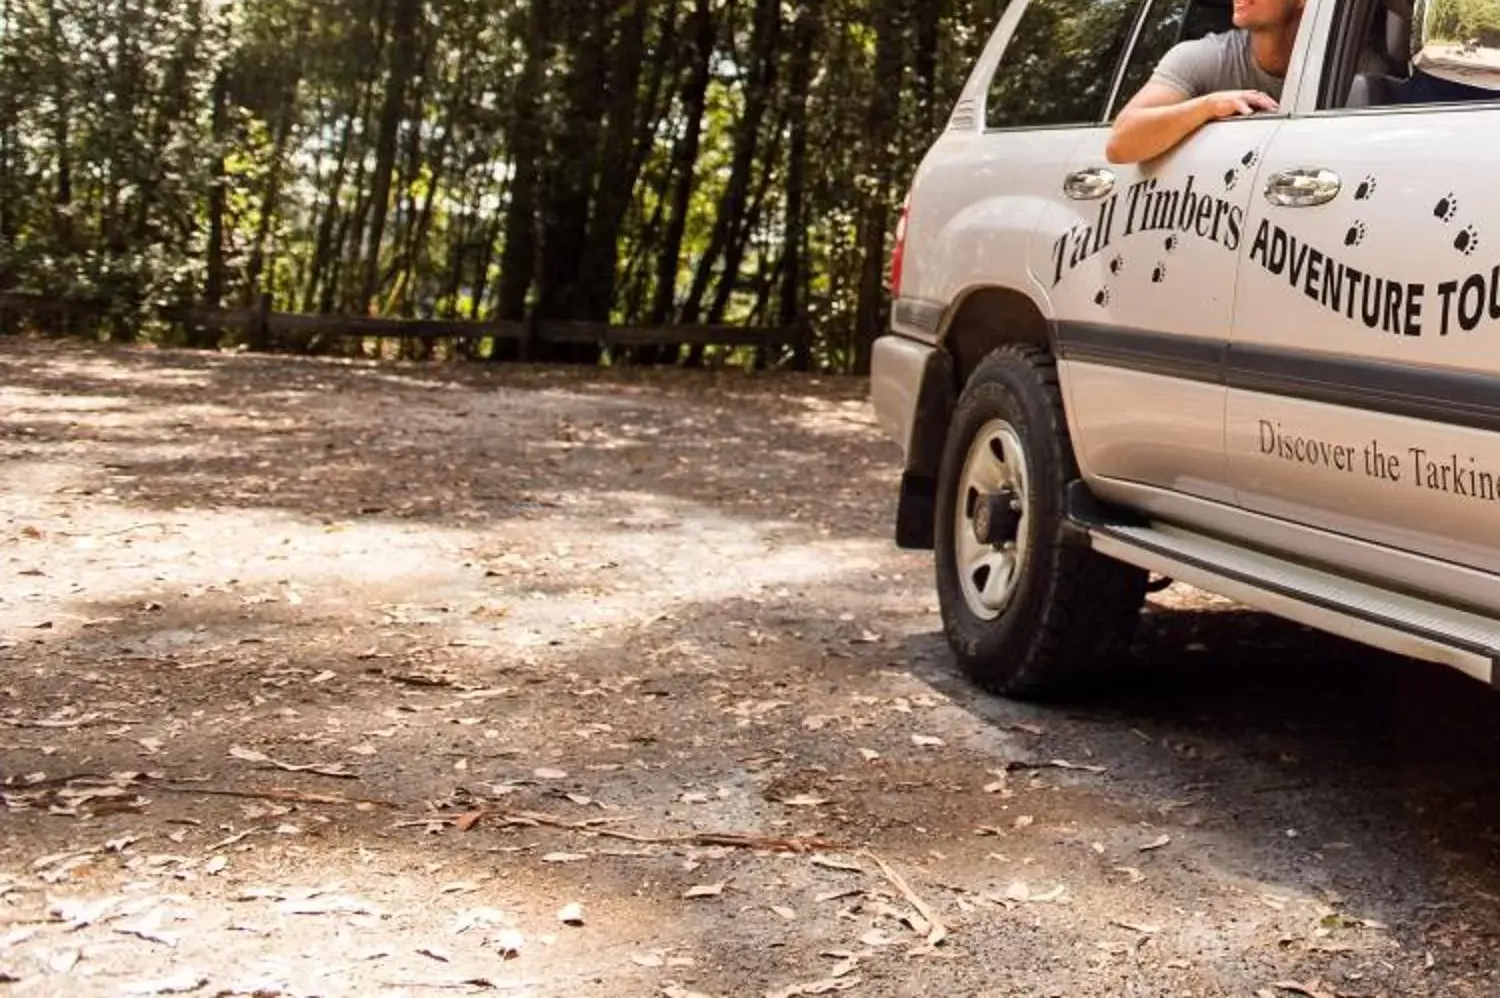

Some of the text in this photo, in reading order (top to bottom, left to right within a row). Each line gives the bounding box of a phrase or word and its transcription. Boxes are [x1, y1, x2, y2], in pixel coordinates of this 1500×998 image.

[1052, 175, 1243, 288] Tall Timbers
[1249, 218, 1425, 336] ADVENTURE
[1258, 419, 1355, 473] Discover
[1363, 440, 1400, 482] the
